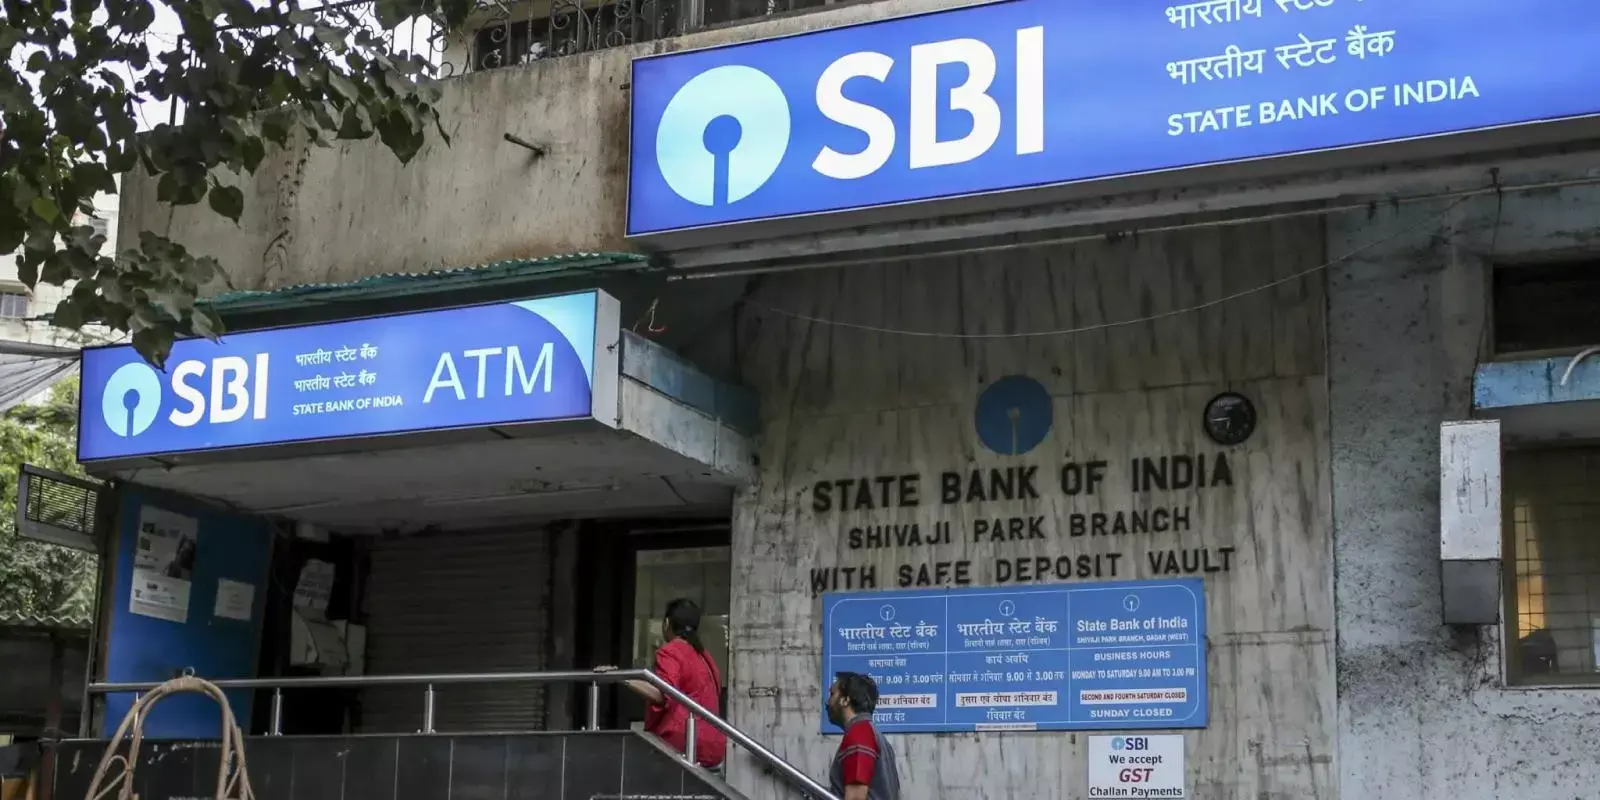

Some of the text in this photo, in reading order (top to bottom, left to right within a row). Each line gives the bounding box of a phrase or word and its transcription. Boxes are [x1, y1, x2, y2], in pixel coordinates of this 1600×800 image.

[1166, 24, 1396, 85] भारतीय स्टेट बैंक
[811, 25, 1044, 179] SBI
[1167, 75, 1480, 136] STATE BANK OF INDIA
[295, 348, 332, 367] भारतीय
[334, 345, 358, 363] स्टेट
[294, 374, 331, 392] भारतीय
[333, 371, 356, 388] स्टेट
[422, 342, 554, 404] ATM
[168, 352, 269, 428] SBI
[292, 395, 404, 416] STATE BANK OF INDIA
[812, 451, 1234, 513] STATE BANK OF INDIA
[849, 506, 1190, 550] SHIVAJI PARK BRANCH
[810, 547, 1235, 593] WITH SAFE DEPOSIT VAULT
[838, 622, 886, 641] भारतीय
[889, 622, 912, 638] स्टेट
[957, 616, 1058, 636] भारतीय स्टेट बैंक
[1077, 616, 1188, 632] State Bank of India
[1094, 650, 1171, 661] BUSINESS HOURS
[886, 675, 903, 685] 9.00
[912, 674, 930, 684] 3.00
[1006, 672, 1025, 682] 9.00
[1035, 671, 1054, 681] 3.00
[1072, 671, 1096, 679] MONDAY
[1098, 670, 1106, 678] TO
[1107, 669, 1137, 678] SATURDAY
[1162, 668, 1171, 677] TO
[1081, 693, 1102, 701] SECOND
[1115, 692, 1136, 700] FOURTH
[1137, 691, 1163, 699] SATURDAY
[1164, 691, 1186, 699] CLOSED
[1090, 707, 1173, 718] SUNDAY CLOSED
[1125, 737, 1148, 751] SBI
[1109, 754, 1163, 765] We accept
[1119, 768, 1154, 783] GST
[1089, 786, 1183, 798] Challan Payments
